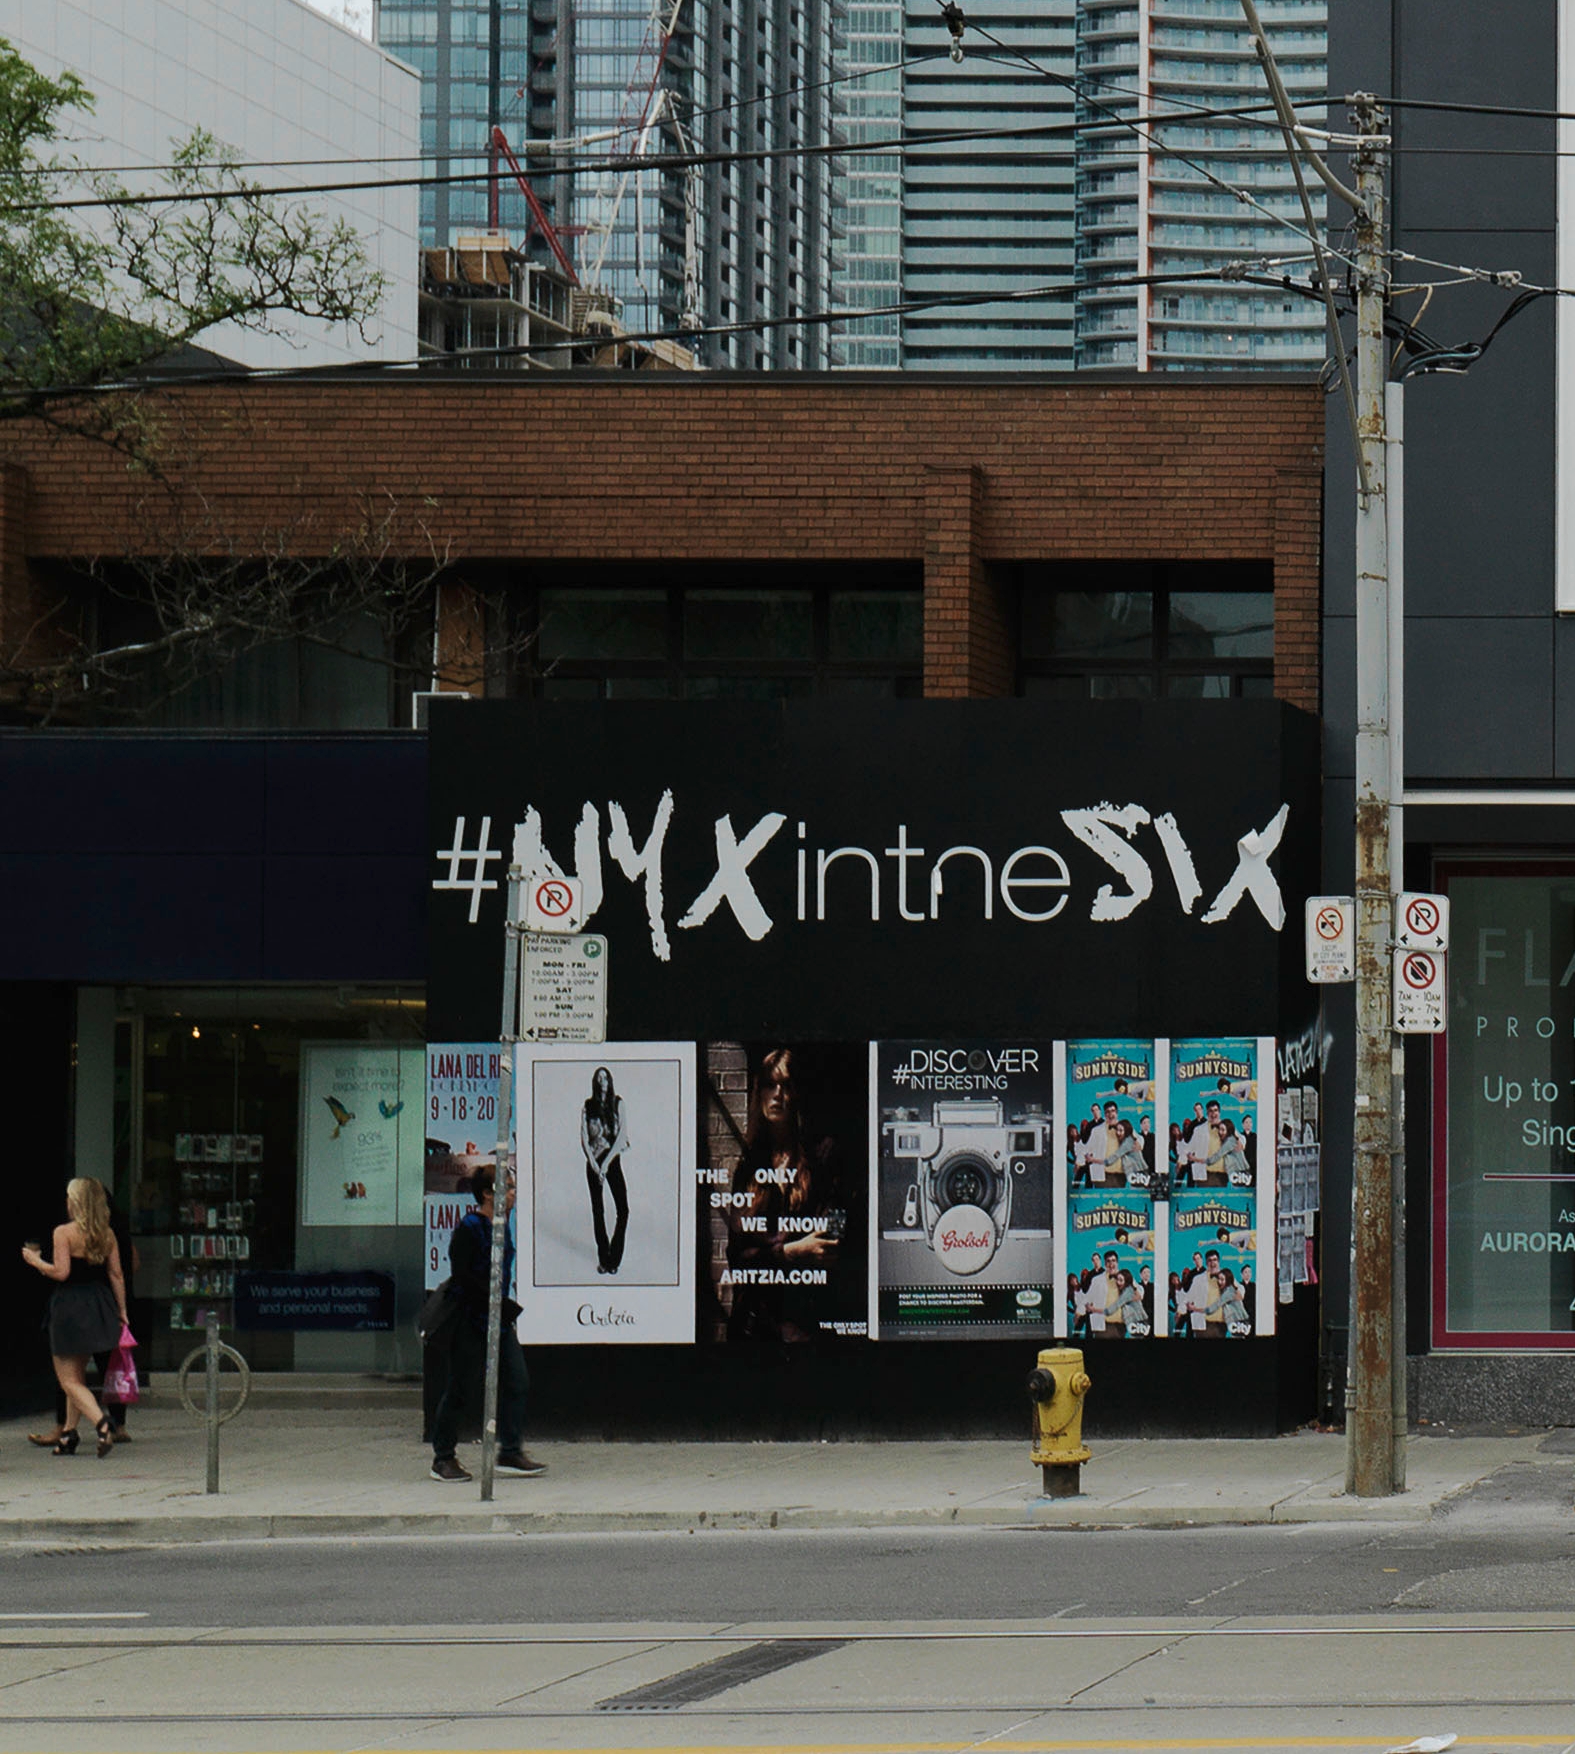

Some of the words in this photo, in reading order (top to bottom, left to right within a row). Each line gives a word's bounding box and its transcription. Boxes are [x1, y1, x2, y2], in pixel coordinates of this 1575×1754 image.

[542, 961, 564, 969] MON
[571, 961, 587, 969] FRI
[1398, 991, 1412, 1001] 7AM
[1399, 1004, 1414, 1014] 3PM
[1425, 1004, 1440, 1014] 7PM
[430, 1054, 463, 1080] LANA
[466, 1054, 487, 1080] DEL
[1075, 1060, 1147, 1080] SUNNYSIDE
[1178, 1060, 1249, 1080] SUNNYSIDE
[911, 1075, 1008, 1090] INTERESTING
[1484, 1076, 1522, 1108] Up
[1531, 1078, 1559, 1103] to
[696, 1168, 729, 1184] THE
[754, 1168, 798, 1184] ONLY
[1127, 1171, 1151, 1187] City
[1229, 1171, 1253, 1187] City
[710, 1192, 756, 1208] SPOT
[740, 1216, 768, 1232] WE
[777, 1216, 829, 1232] KNOW
[1076, 1209, 1147, 1230] SUNNYSIDE
[1177, 1209, 1248, 1229] SUNNYSIDE
[941, 1230, 990, 1252] Grolsch
[719, 1269, 827, 1285] ARITZIA.COM
[331, 1286, 381, 1297] business
[1127, 1321, 1151, 1337] City
[1228, 1321, 1252, 1337] City
